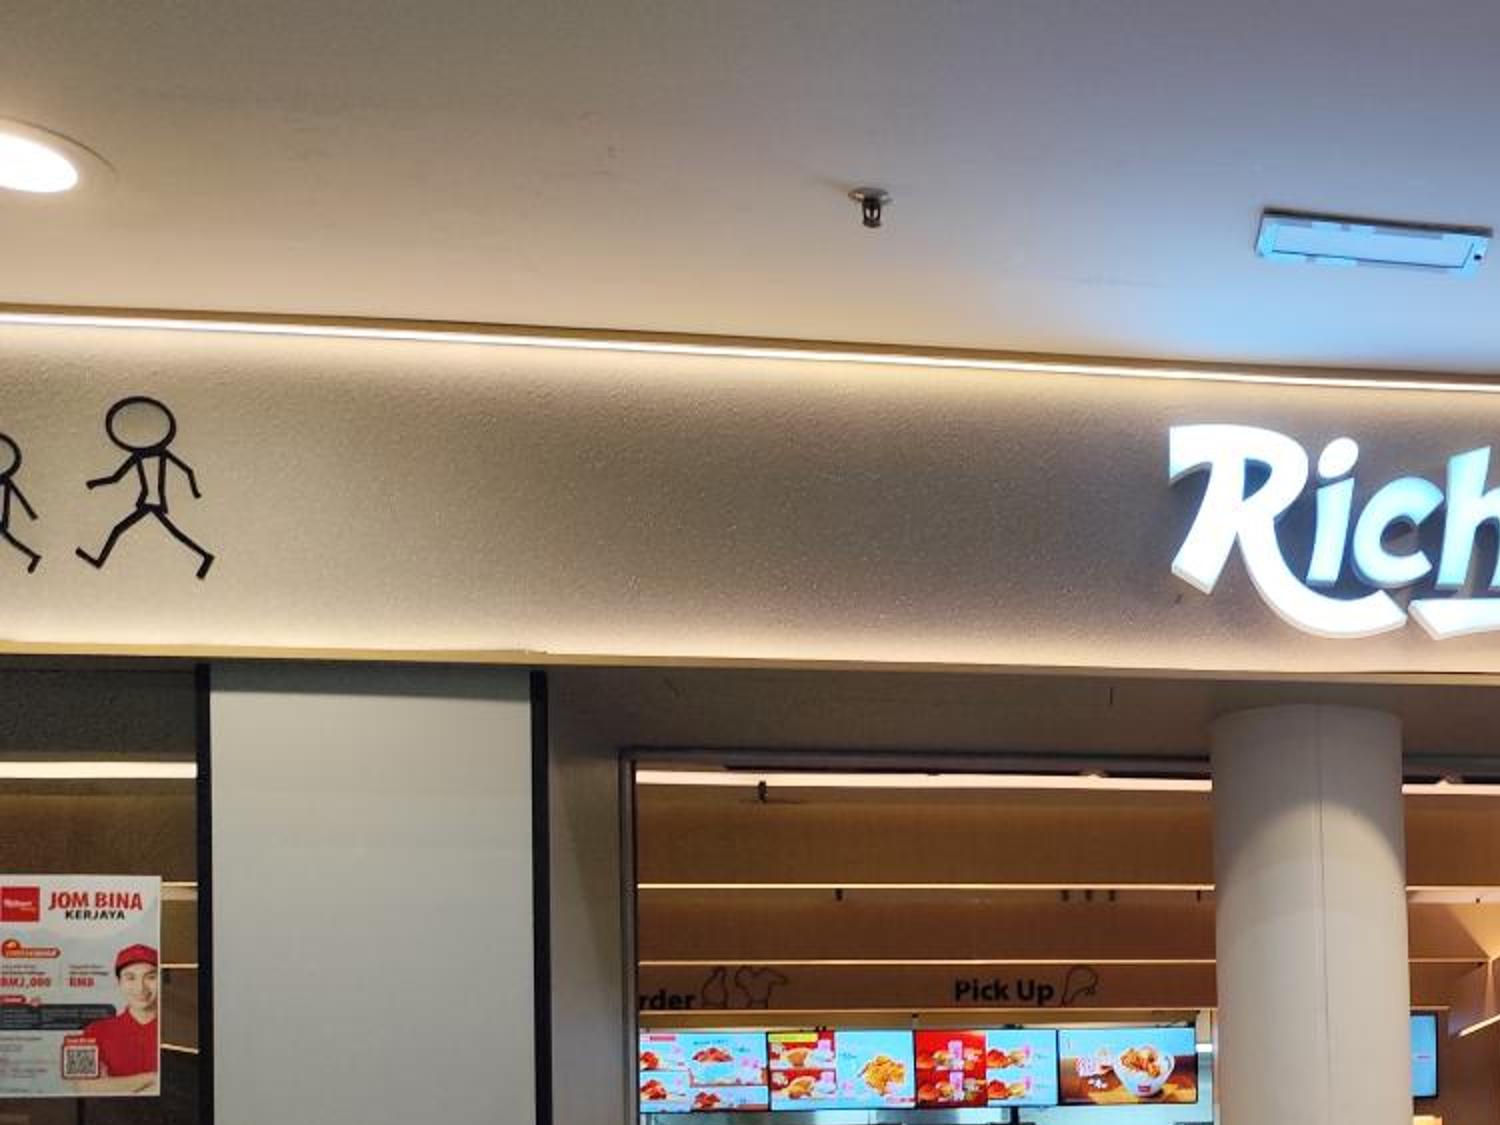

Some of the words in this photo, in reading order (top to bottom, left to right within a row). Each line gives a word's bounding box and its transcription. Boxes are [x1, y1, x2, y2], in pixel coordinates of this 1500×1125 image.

[48, 891, 89, 911] JOM
[95, 891, 143, 911] BINA
[65, 909, 125, 921] KERJAYA
[640, 989, 696, 1010] rder
[955, 979, 1009, 1001] Pick
[1017, 980, 1054, 1004] Up
